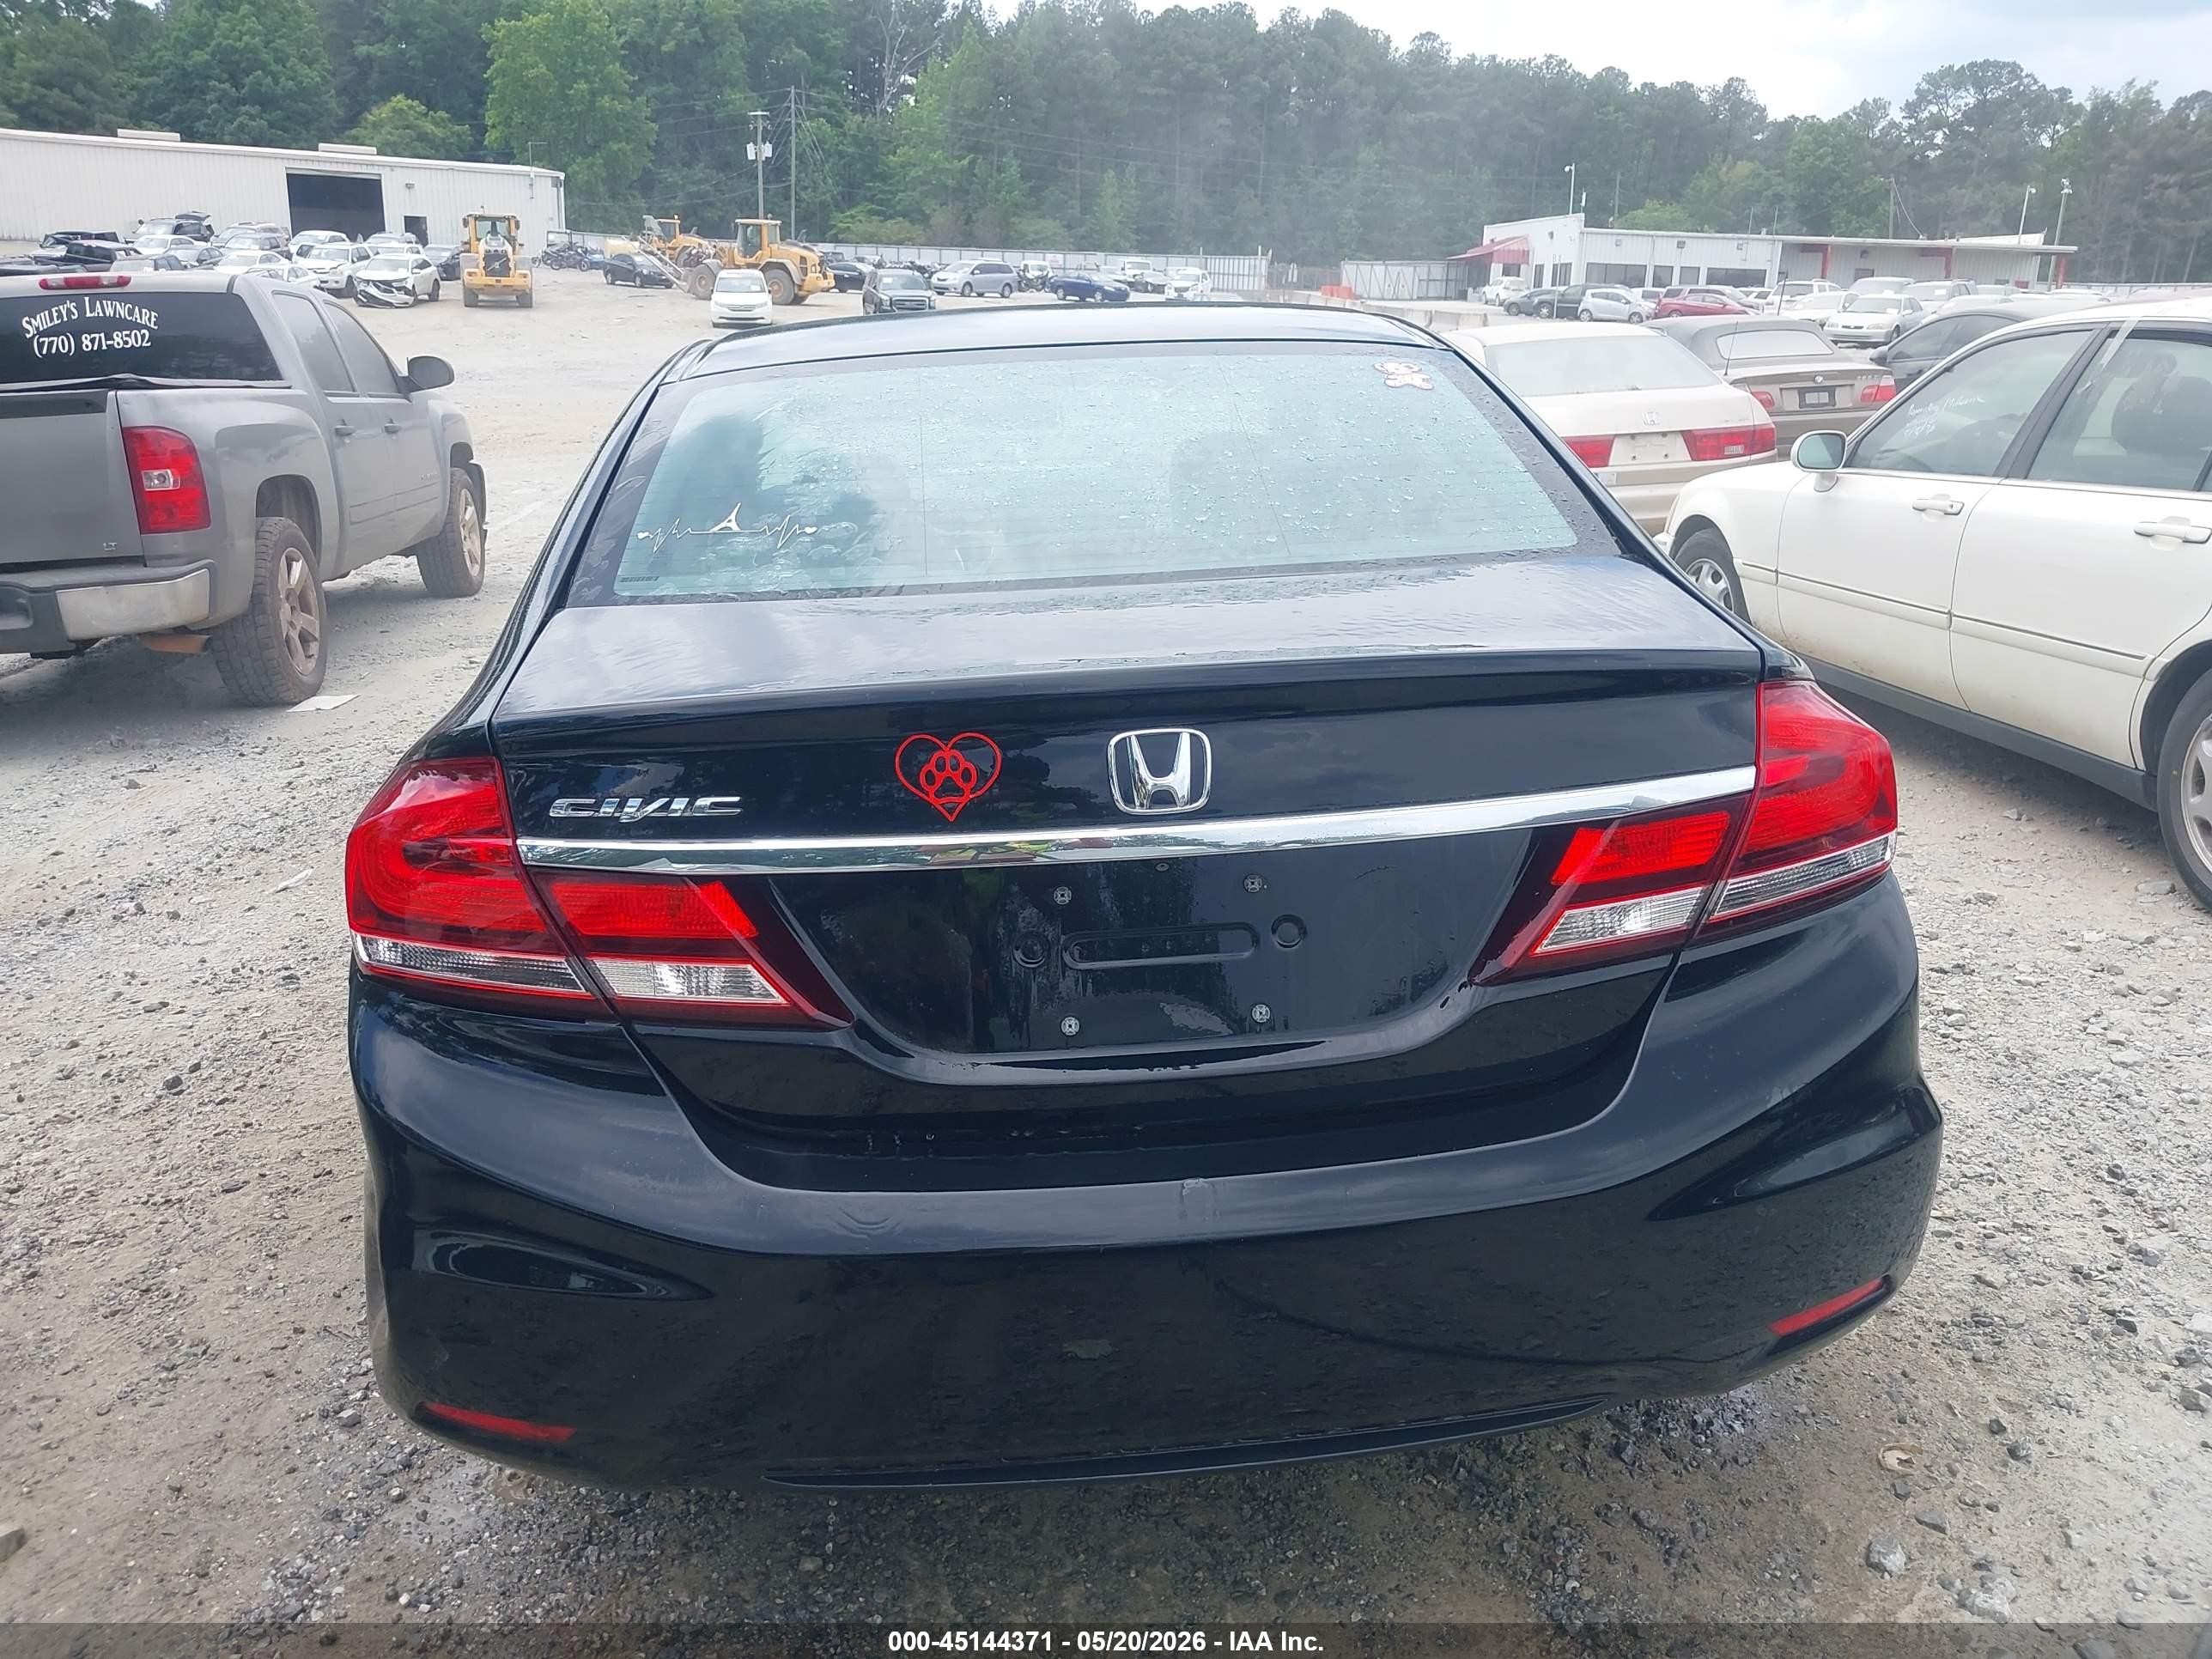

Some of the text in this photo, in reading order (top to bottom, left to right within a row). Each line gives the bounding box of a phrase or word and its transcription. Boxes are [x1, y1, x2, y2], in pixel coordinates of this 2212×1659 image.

[21, 296, 159, 339] SMILEY'S LAWNCARE
[33, 329, 152, 358] (770) 871-8502
[549, 796, 743, 823] CIVIC
